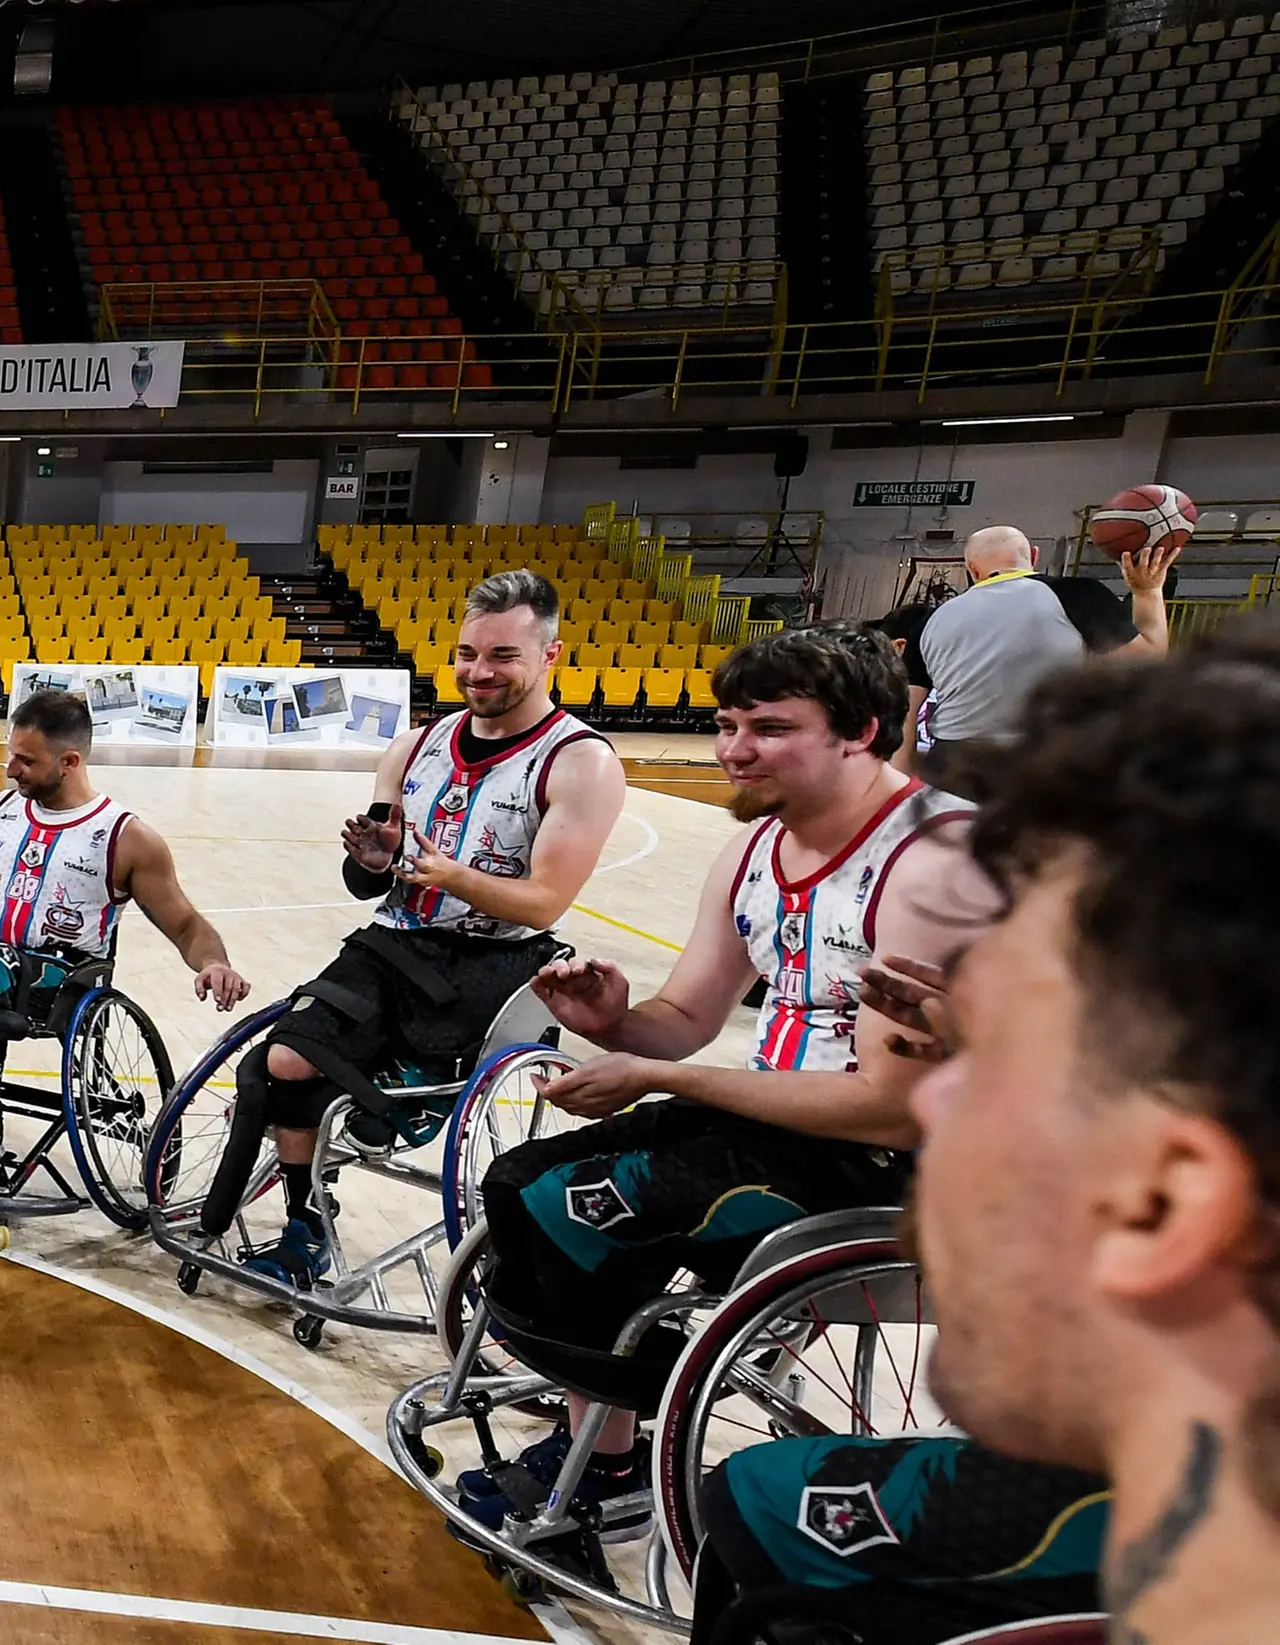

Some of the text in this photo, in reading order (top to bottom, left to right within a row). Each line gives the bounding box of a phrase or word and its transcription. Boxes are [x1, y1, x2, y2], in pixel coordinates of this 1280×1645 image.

[330, 483, 354, 493] BAR
[868, 484, 906, 494] LOCALE
[881, 494, 942, 504] EMERGENZE
[432, 820, 462, 855] 15
[63, 860, 98, 877] YUMBACA
[7, 871, 41, 903] 88
